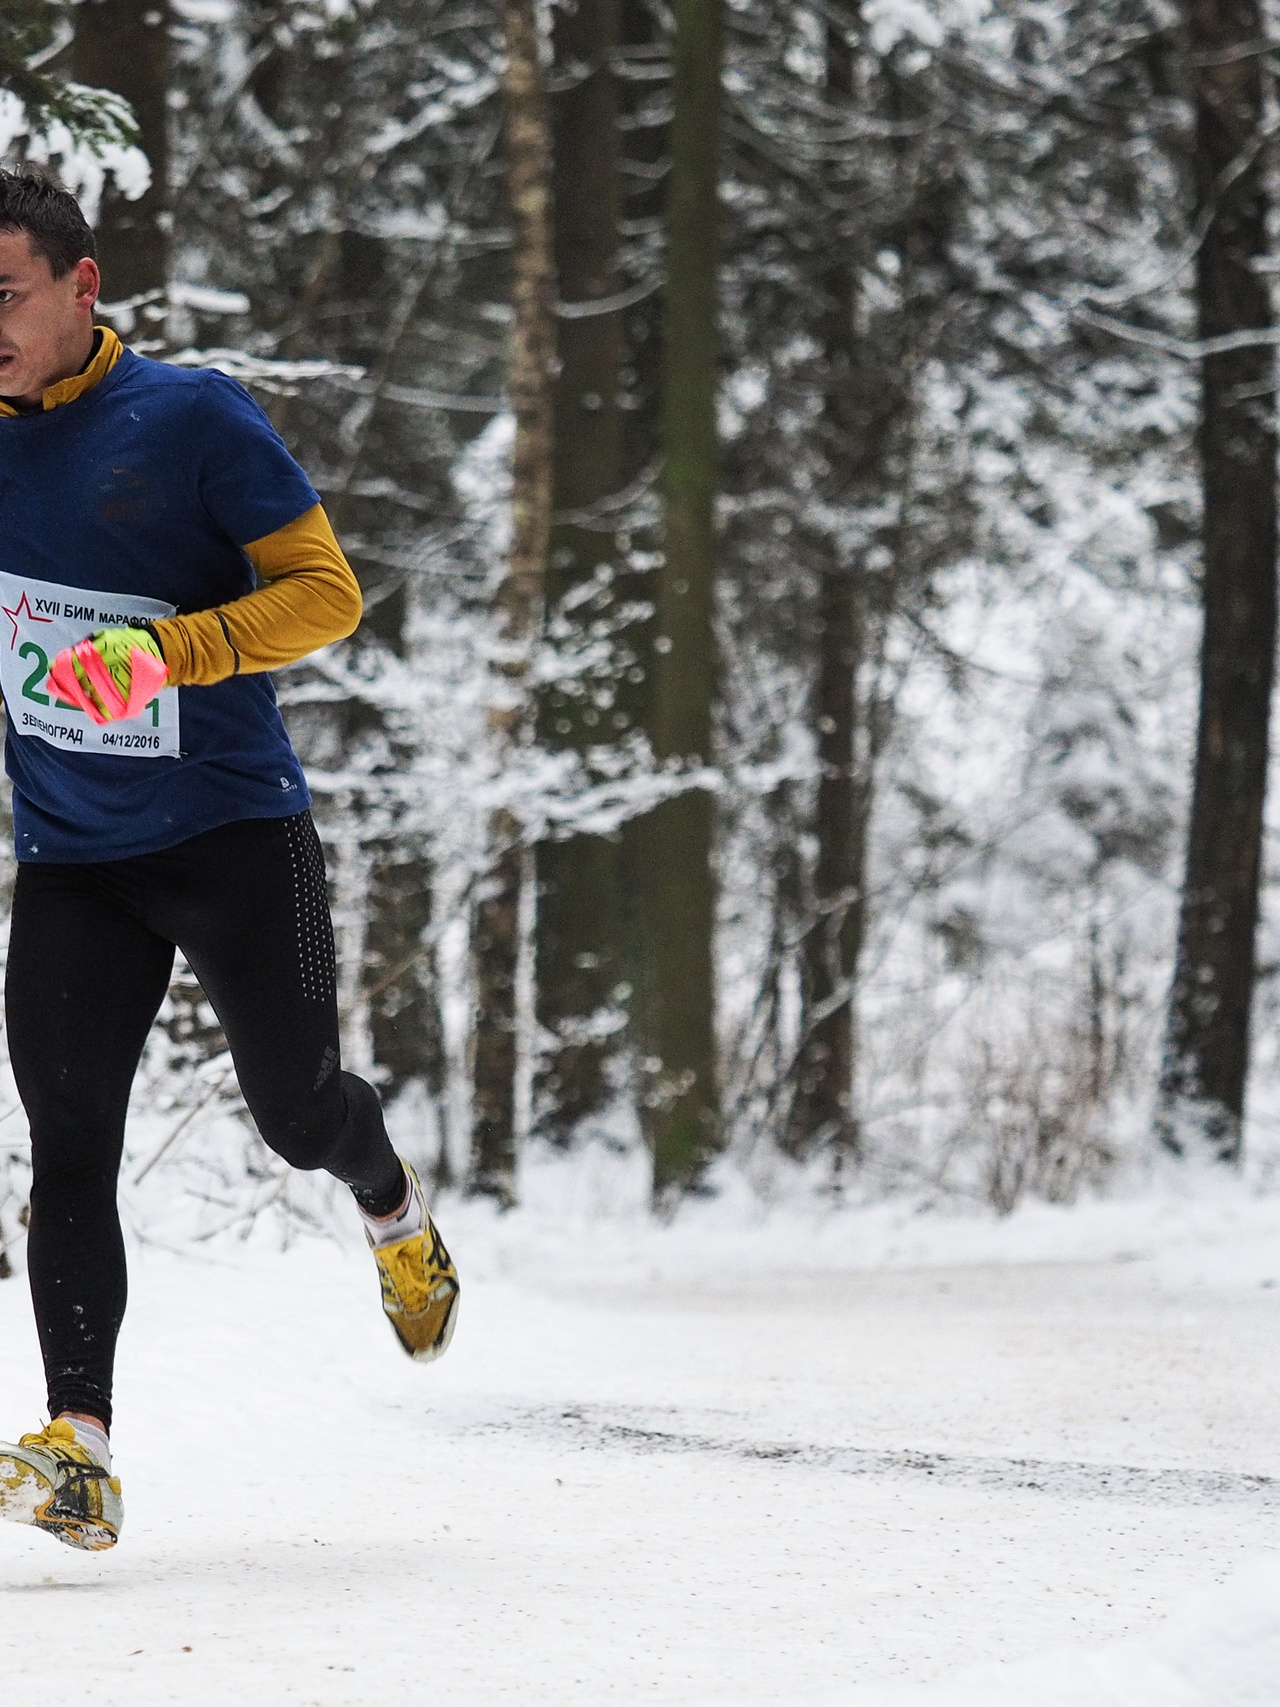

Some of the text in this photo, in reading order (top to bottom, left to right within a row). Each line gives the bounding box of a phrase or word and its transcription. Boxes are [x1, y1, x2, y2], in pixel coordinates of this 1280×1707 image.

[63, 604, 95, 622] БИМ
[22, 712, 160, 749] ЗЕЛЕНОГРАД 04/12/2016
